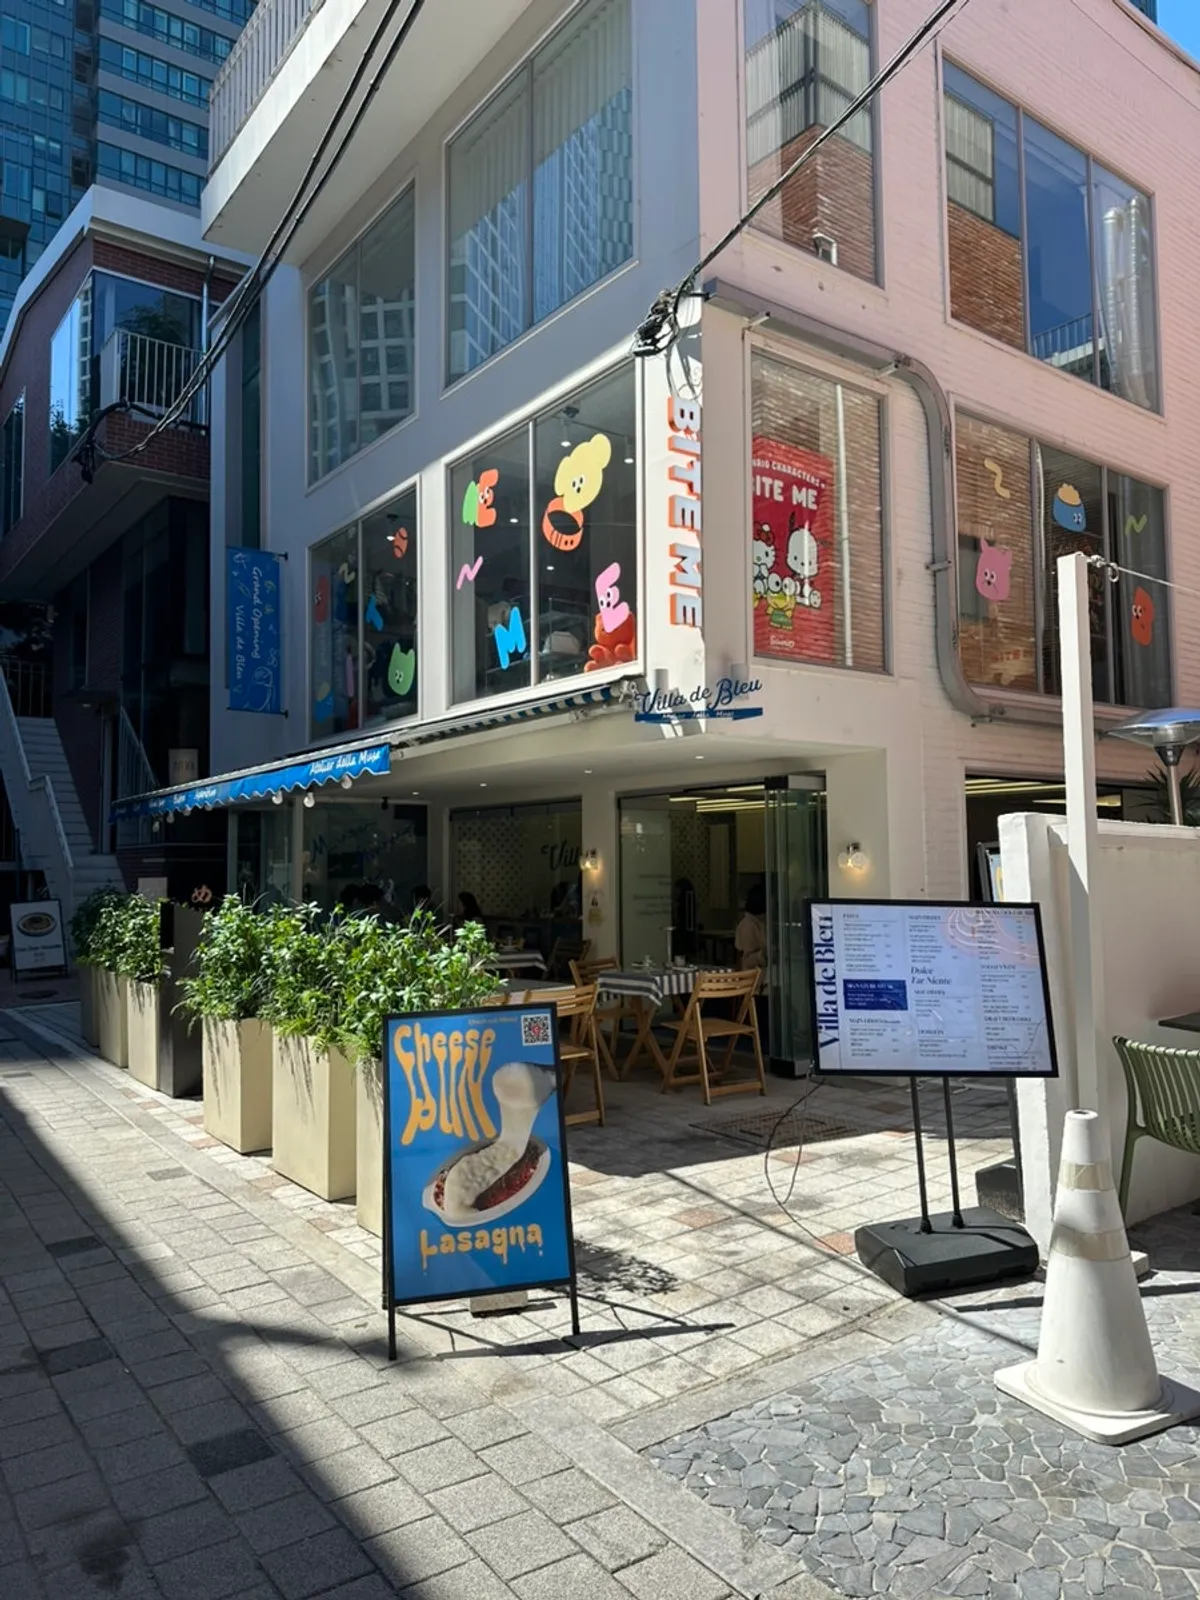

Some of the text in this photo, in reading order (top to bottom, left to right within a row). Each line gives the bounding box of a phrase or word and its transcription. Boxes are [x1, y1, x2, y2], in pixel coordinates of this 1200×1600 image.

[771, 460, 820, 487] CHARACTERS
[752, 475, 818, 510] ITE ME
[667, 396, 702, 628] BITE ME
[236, 604, 245, 633] Villa
[251, 566, 263, 659] Grand Opening
[236, 635, 246, 650] de
[634, 678, 763, 714] Villa de Bleu
[309, 750, 381, 776] Atelier della Muse
[541, 838, 583, 871] Vill
[814, 916, 840, 1048] Villa de Bleu
[394, 1022, 496, 1070] Cheese
[420, 1223, 543, 1268] Lasagna
